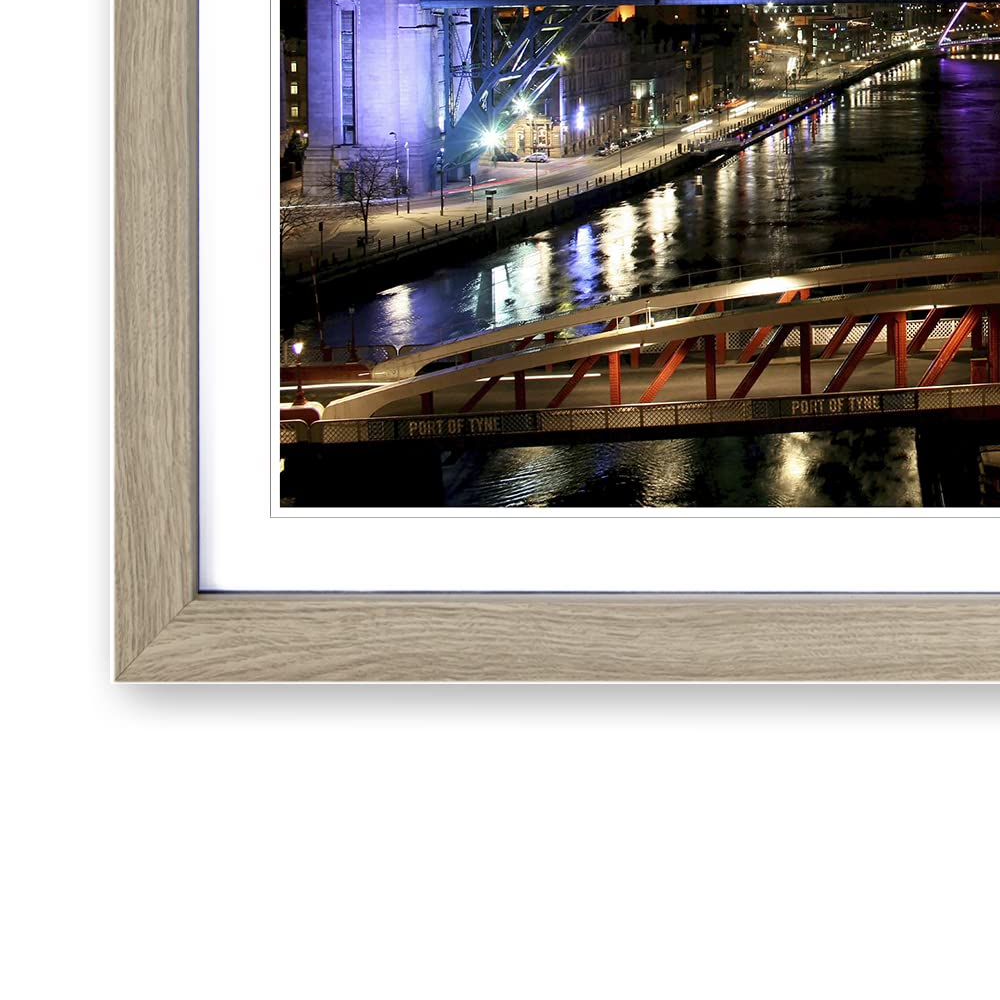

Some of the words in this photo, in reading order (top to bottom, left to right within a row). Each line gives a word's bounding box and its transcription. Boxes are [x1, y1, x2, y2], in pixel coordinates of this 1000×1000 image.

[792, 399, 824, 415] PORT
[829, 398, 844, 413] OF
[848, 395, 880, 411] TYNE
[409, 420, 444, 436] PORT
[448, 418, 464, 434] OF
[468, 416, 499, 432] TYNE
